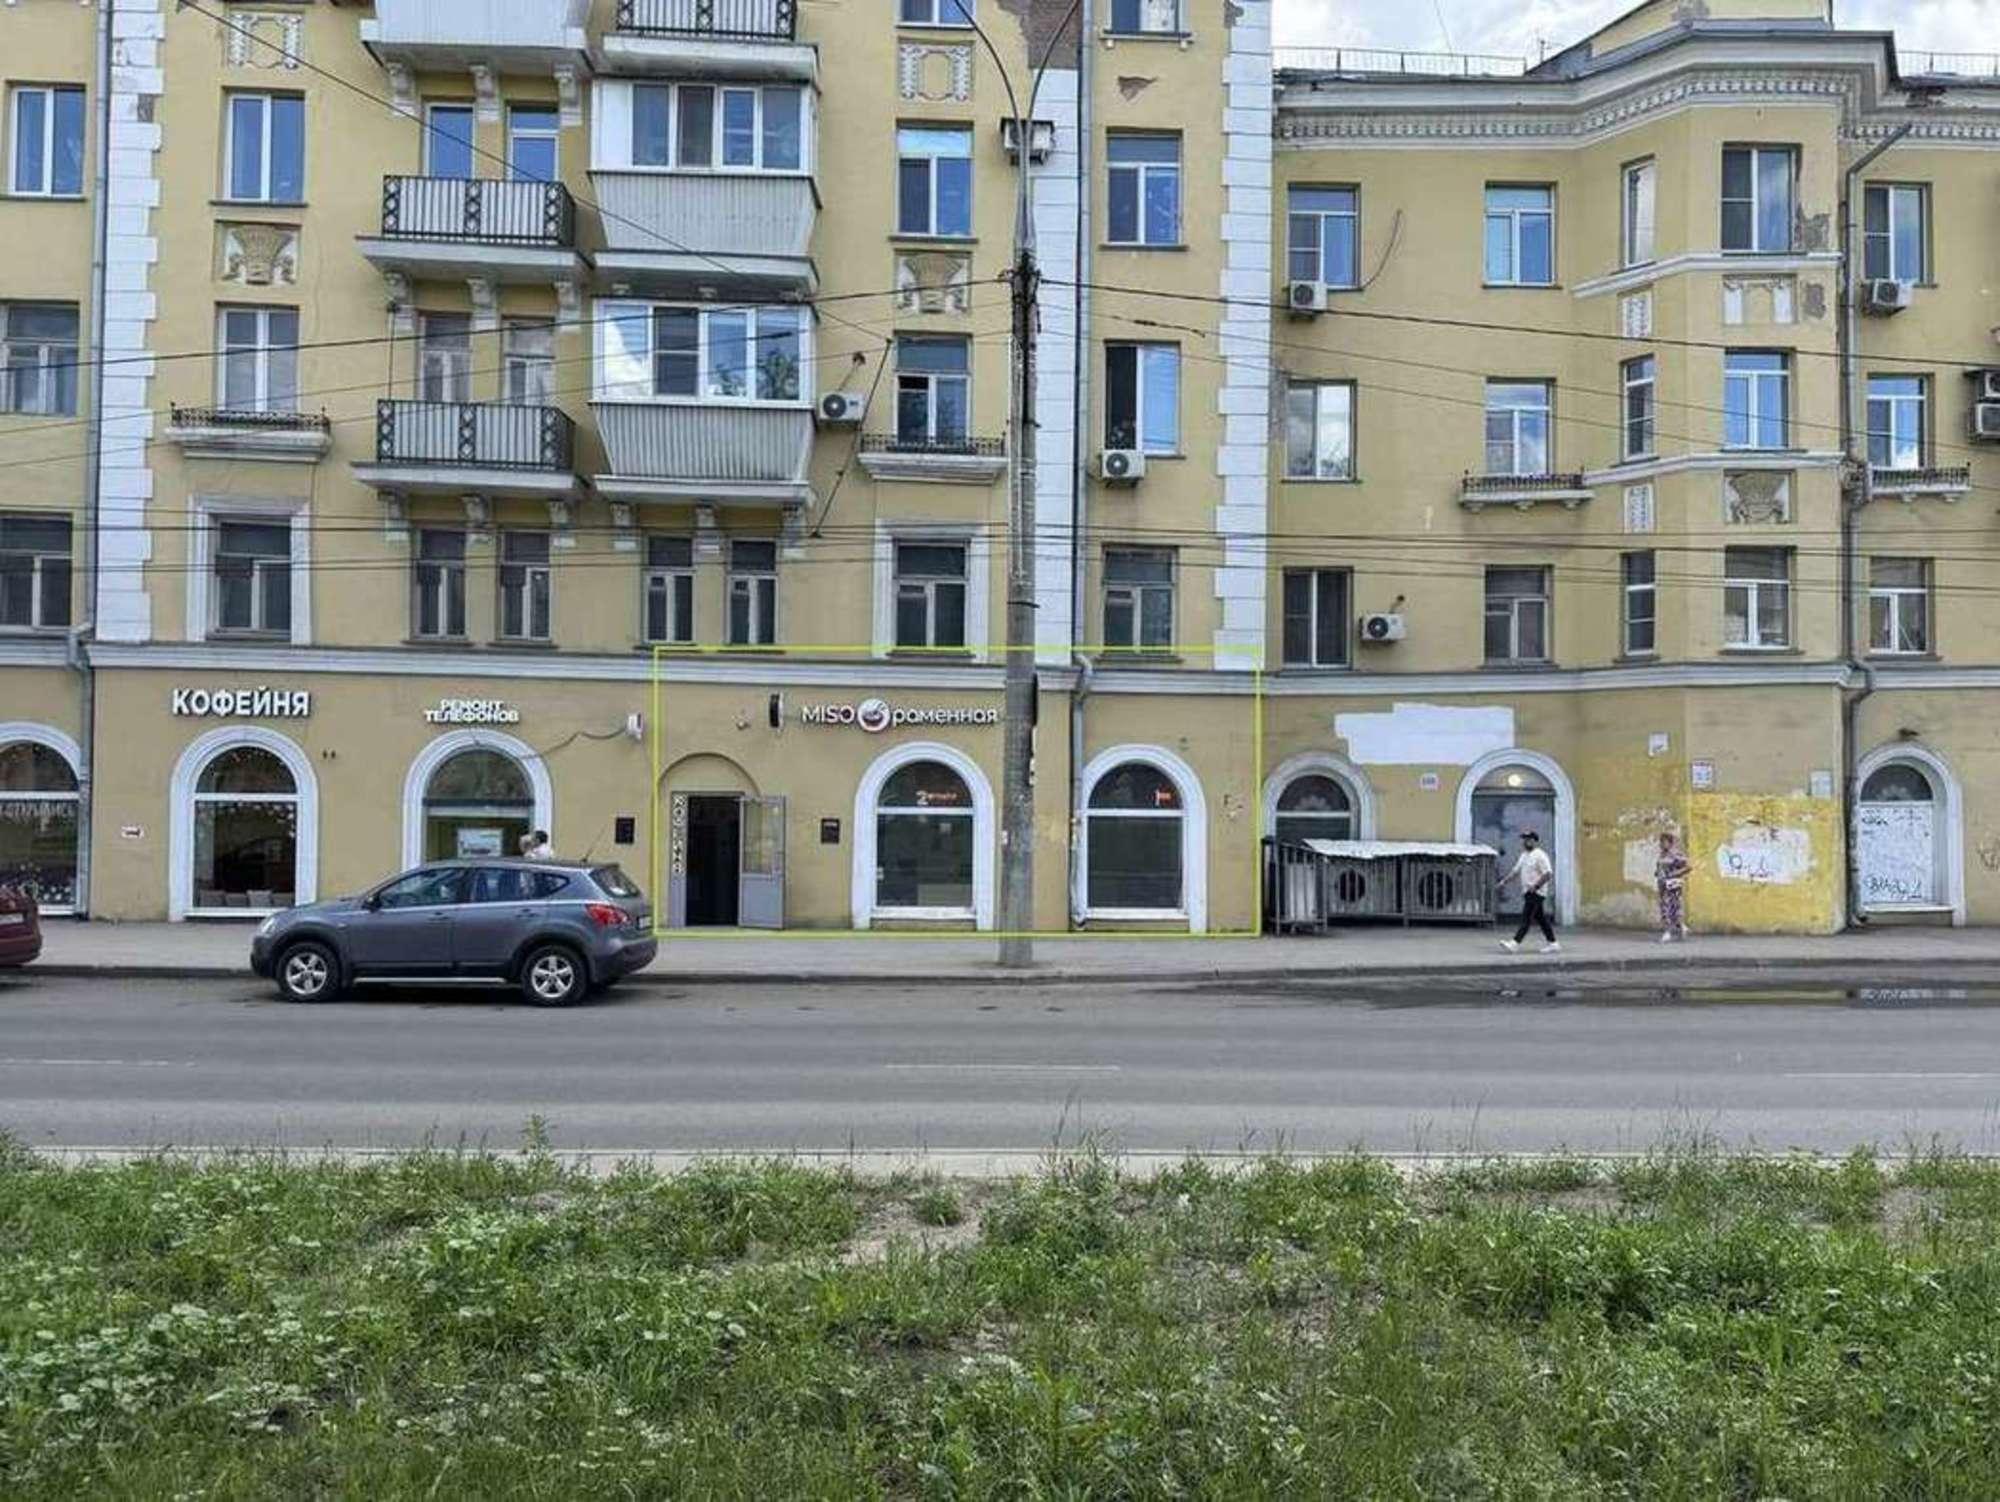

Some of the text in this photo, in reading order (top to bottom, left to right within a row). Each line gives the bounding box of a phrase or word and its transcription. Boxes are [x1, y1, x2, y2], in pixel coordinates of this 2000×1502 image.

[172, 686, 309, 716] КОФЕЙНЯ
[441, 699, 504, 711] РЕМОНТ
[424, 709, 519, 723] ТЕЛЕФОНОВ
[802, 704, 999, 727] MISO раменная
